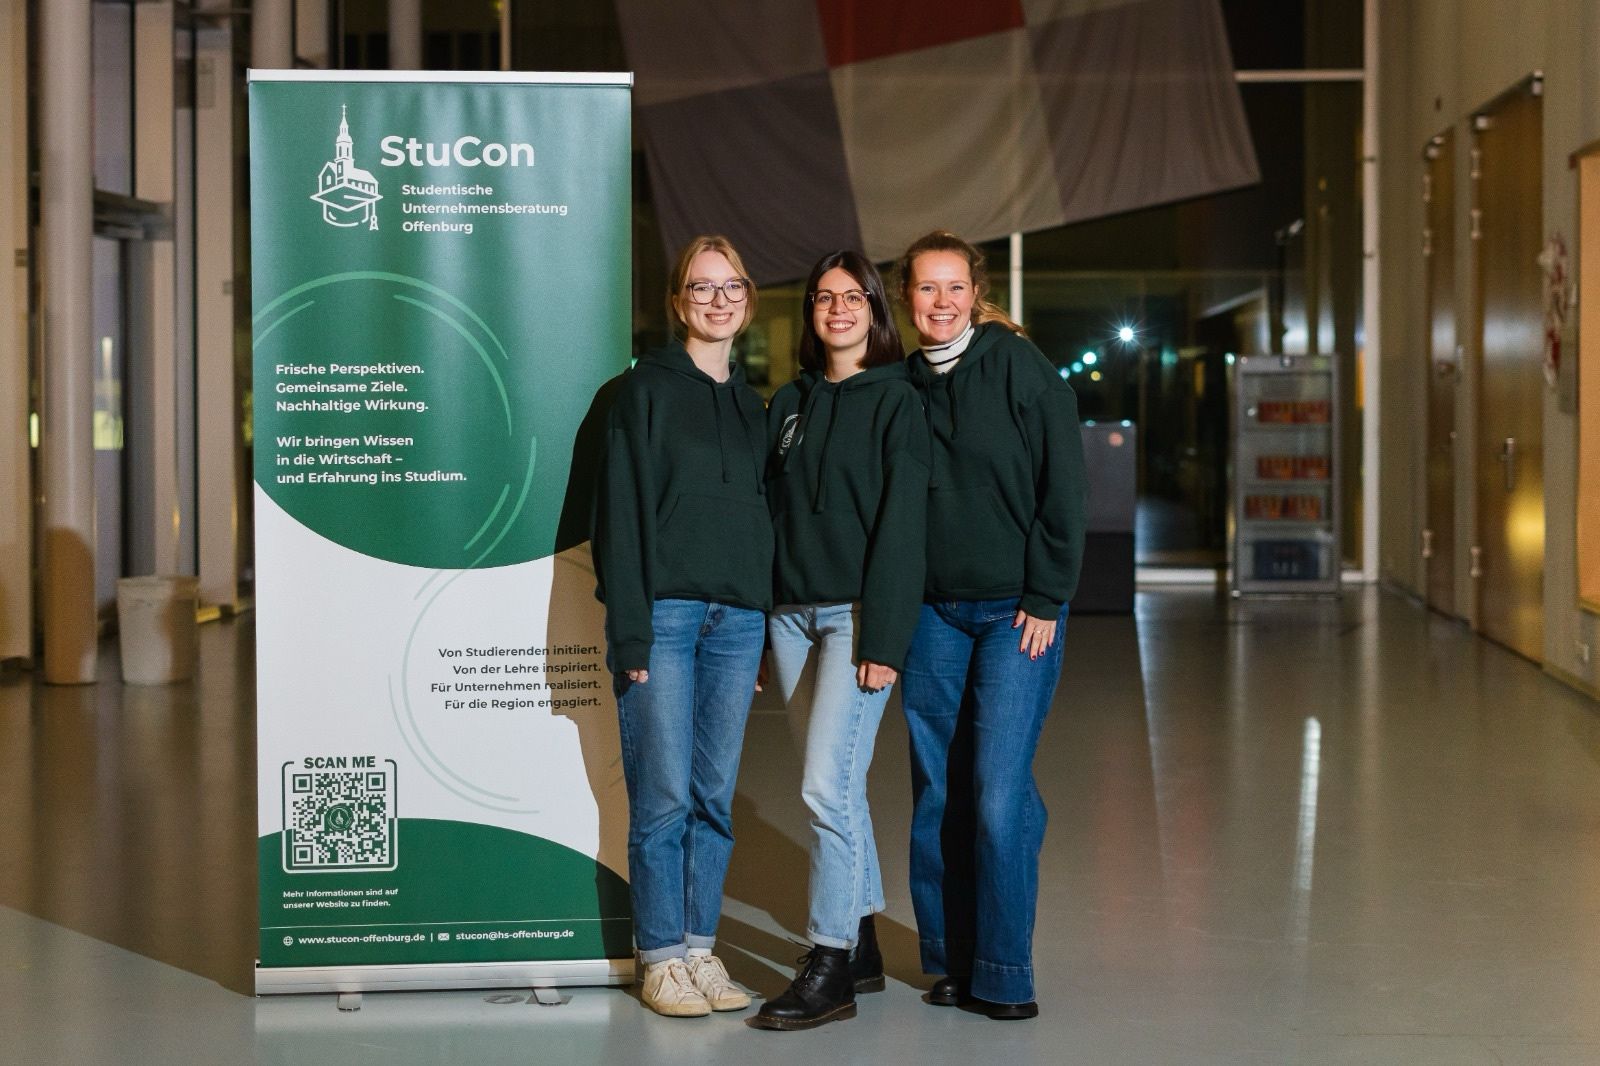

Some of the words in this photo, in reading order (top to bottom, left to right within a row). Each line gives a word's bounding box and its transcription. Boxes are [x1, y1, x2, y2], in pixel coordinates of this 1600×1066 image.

[380, 135, 535, 167] StuCon
[401, 183, 494, 196] Studentische
[402, 202, 568, 216] Unternehmensberatung
[402, 220, 474, 235] Offenburg
[275, 363, 327, 375] Frische
[329, 362, 425, 377] Perspektiven.
[275, 381, 368, 394] Gemeinsame
[370, 380, 408, 393] Ziele.
[276, 399, 362, 414] Nachhaltige
[364, 398, 429, 413] Wirkung.
[276, 435, 302, 448] Wir
[304, 435, 360, 449] bringen
[363, 434, 414, 447] Wissen
[276, 453, 290, 466] in
[294, 453, 316, 466] die
[318, 452, 393, 465] Wirtschaft
[276, 472, 305, 484] und
[308, 471, 378, 485] Erfahrung
[381, 470, 402, 483] ins
[404, 469, 467, 483] Studium.
[438, 648, 463, 658] Von
[465, 645, 550, 657] Studierenden
[553, 644, 601, 656] initiiert.
[452, 665, 477, 675] Von
[480, 664, 502, 674] der
[504, 663, 539, 674] Lehre
[543, 662, 602, 676] inspiriert.
[431, 682, 452, 693] Für
[454, 680, 541, 692] Unternehmen
[544, 679, 602, 692] realisiert.
[444, 699, 466, 710] Für
[468, 698, 488, 709] die
[491, 697, 535, 711] Region
[537, 697, 602, 711] engagiert.
[303, 756, 347, 770] SCAN
[352, 755, 376, 769] ME
[282, 890, 305, 898] Mehr
[305, 889, 364, 898] Informationen
[365, 888, 383, 896] sind
[384, 888, 399, 896] auf
[282, 901, 314, 909] unserer
[315, 899, 349, 908] Website
[361, 899, 391, 907] finden.
[298, 933, 426, 945] www.stucon-offenburg.de
[455, 929, 575, 941] stucon@hs-offenburg.de
